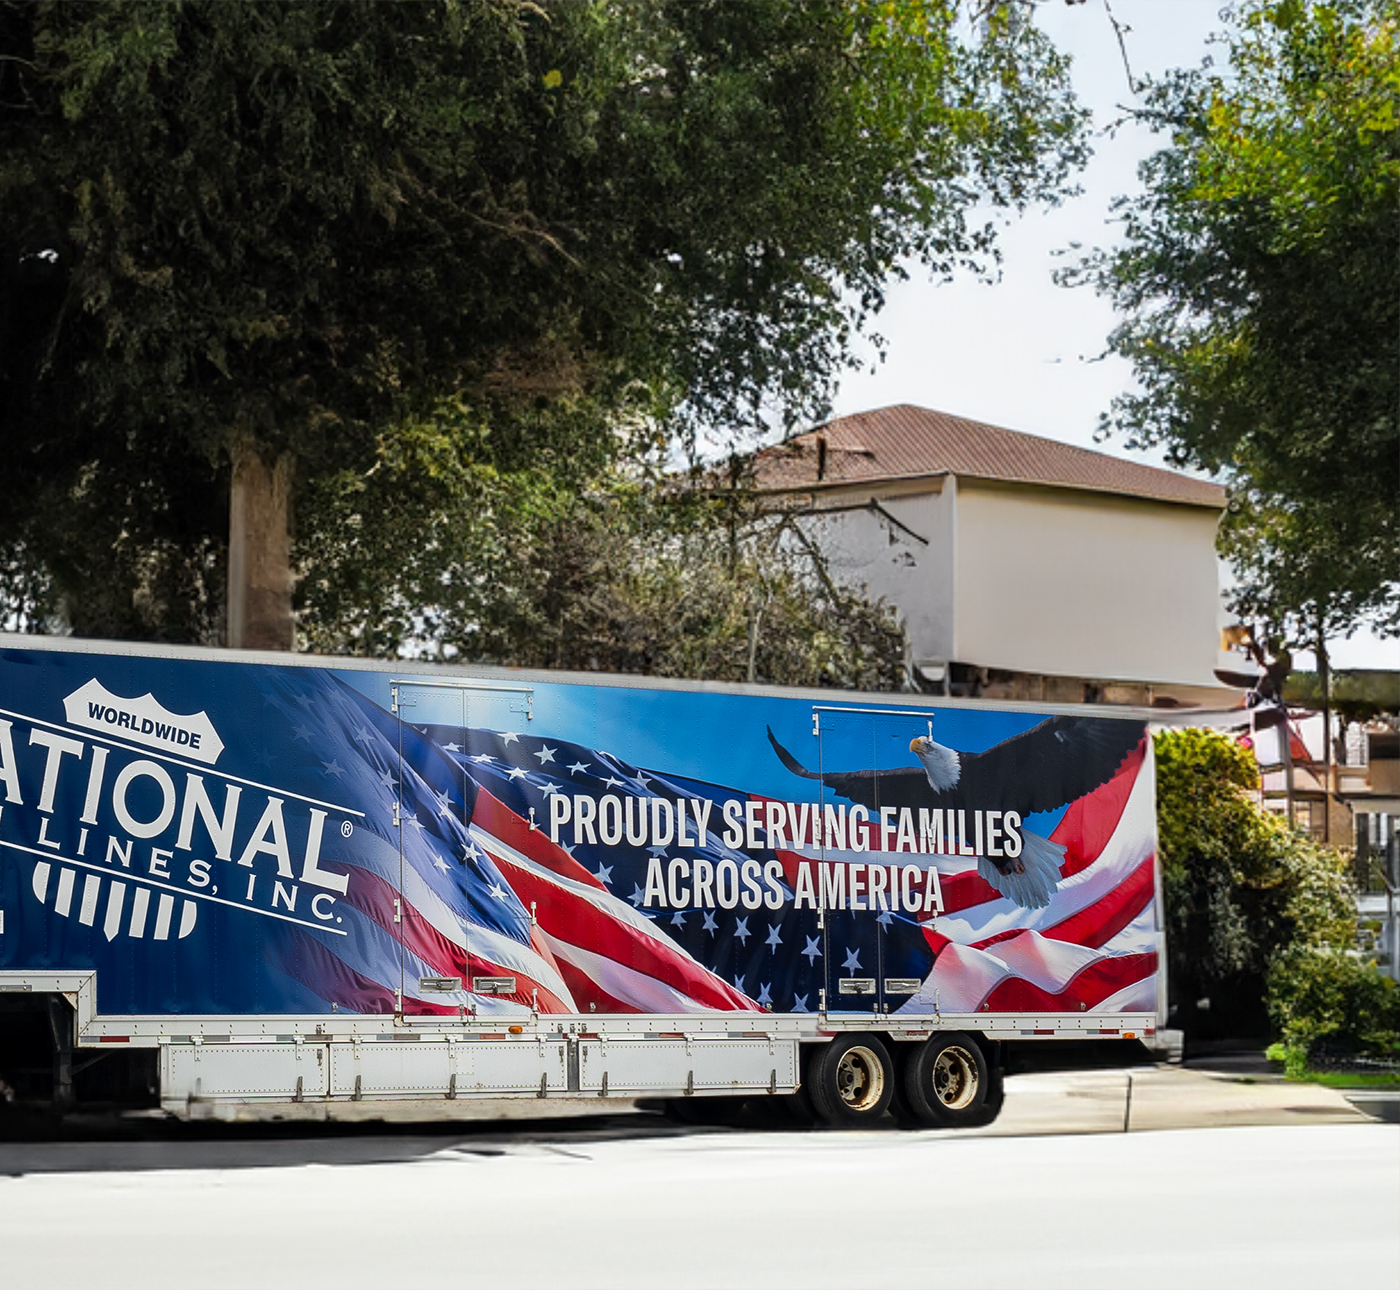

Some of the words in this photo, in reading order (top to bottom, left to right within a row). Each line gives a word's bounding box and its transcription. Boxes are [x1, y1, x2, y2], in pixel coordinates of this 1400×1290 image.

[88, 702, 202, 750] WORLDWIDE
[549, 793, 713, 849] PROUDLY
[722, 799, 871, 854] SERVING
[880, 807, 1023, 858] FAMILIES
[37, 817, 220, 896] LINES,
[244, 873, 344, 924] INC.
[643, 857, 784, 910] ACROSS
[795, 862, 944, 912] AMERICA
